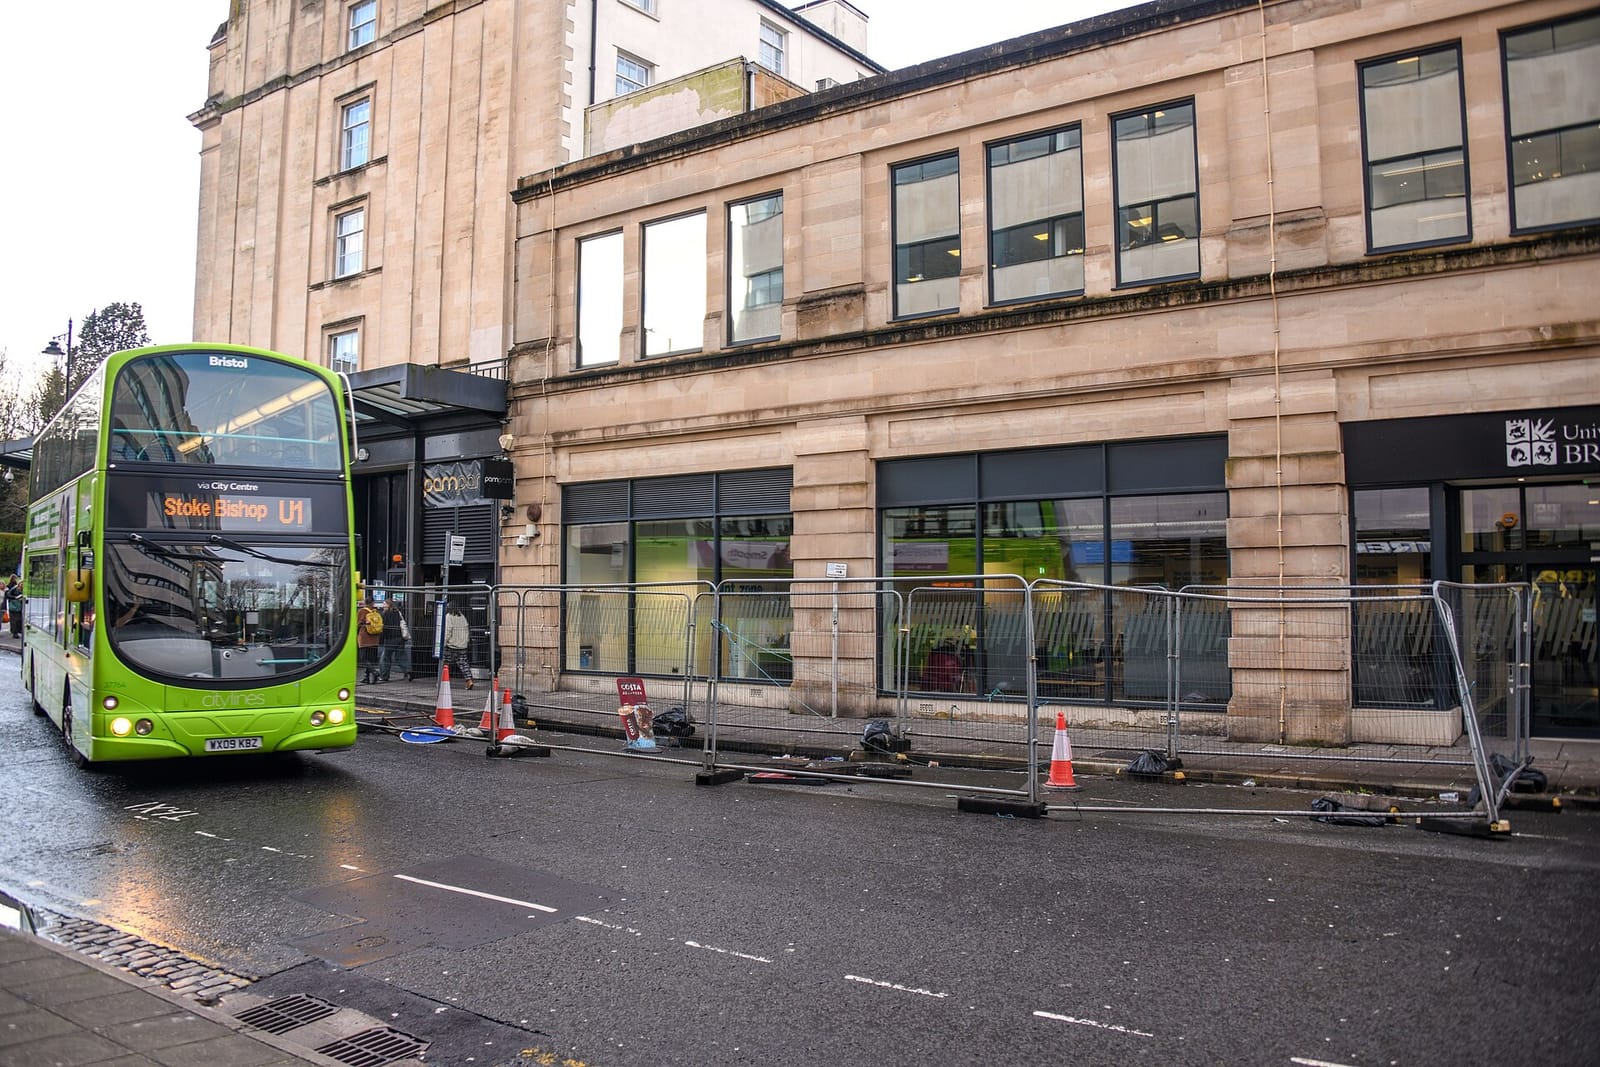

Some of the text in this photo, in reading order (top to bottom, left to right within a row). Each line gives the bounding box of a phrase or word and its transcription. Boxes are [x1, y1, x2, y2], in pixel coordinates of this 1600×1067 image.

[209, 356, 248, 369] Bristol
[211, 482, 229, 491] City
[230, 482, 259, 491] Centre
[164, 497, 304, 527] Stoke Bishop U1
[202, 692, 265, 710] citylines
[210, 738, 258, 750] WX09 KBZ
